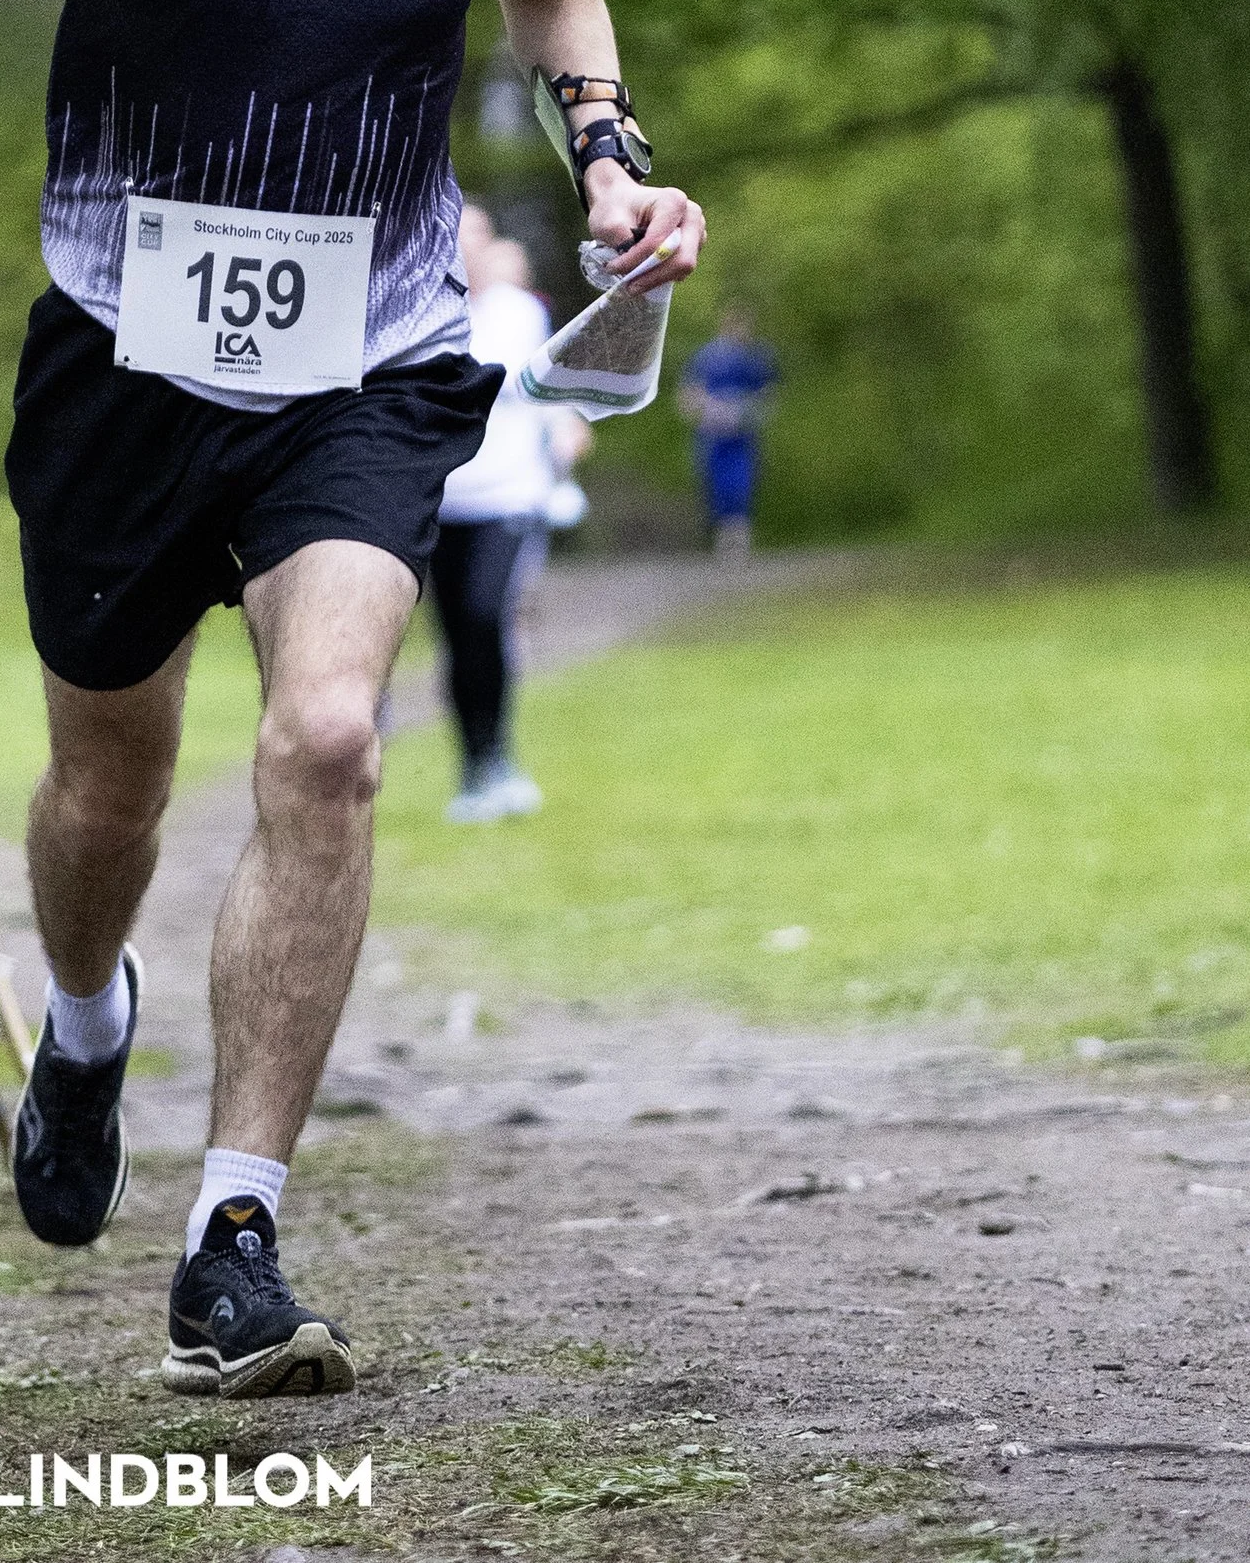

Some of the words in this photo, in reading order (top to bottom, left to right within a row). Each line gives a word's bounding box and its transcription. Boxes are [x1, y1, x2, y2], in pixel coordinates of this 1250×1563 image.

[193, 219, 261, 239] Stockholm
[265, 227, 291, 244] City
[295, 229, 320, 245] Cup
[324, 230, 354, 244] 2025
[186, 251, 306, 330] 159
[215, 331, 262, 357] ICA
[237, 356, 262, 366] nära
